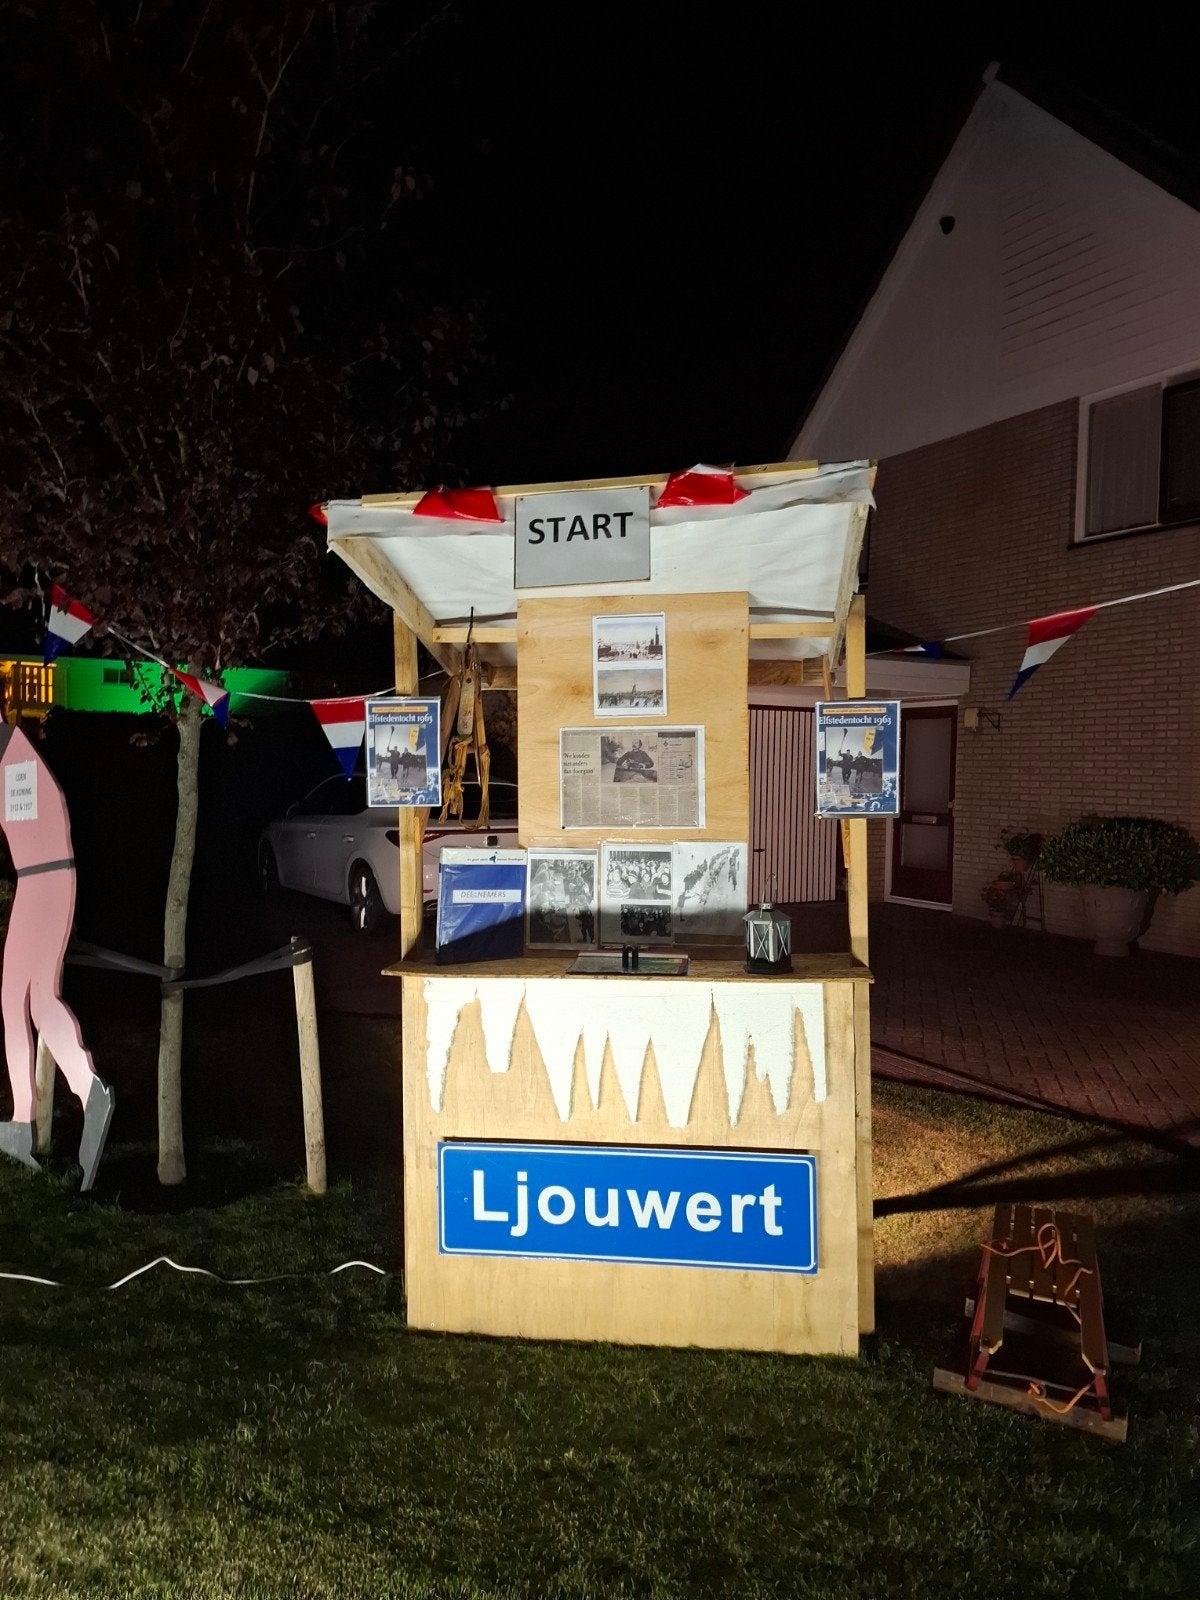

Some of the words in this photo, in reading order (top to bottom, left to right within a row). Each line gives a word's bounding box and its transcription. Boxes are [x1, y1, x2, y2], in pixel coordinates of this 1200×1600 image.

[528, 512, 633, 544] START
[369, 713, 415, 723] Elfstedentocht
[417, 713, 433, 724] 1963
[819, 715, 872, 725] Elfstedentocht
[873, 714, 892, 726] 1963
[460, 890, 506, 900] DEELNEMERS
[472, 1169, 784, 1238] Ljouwert
